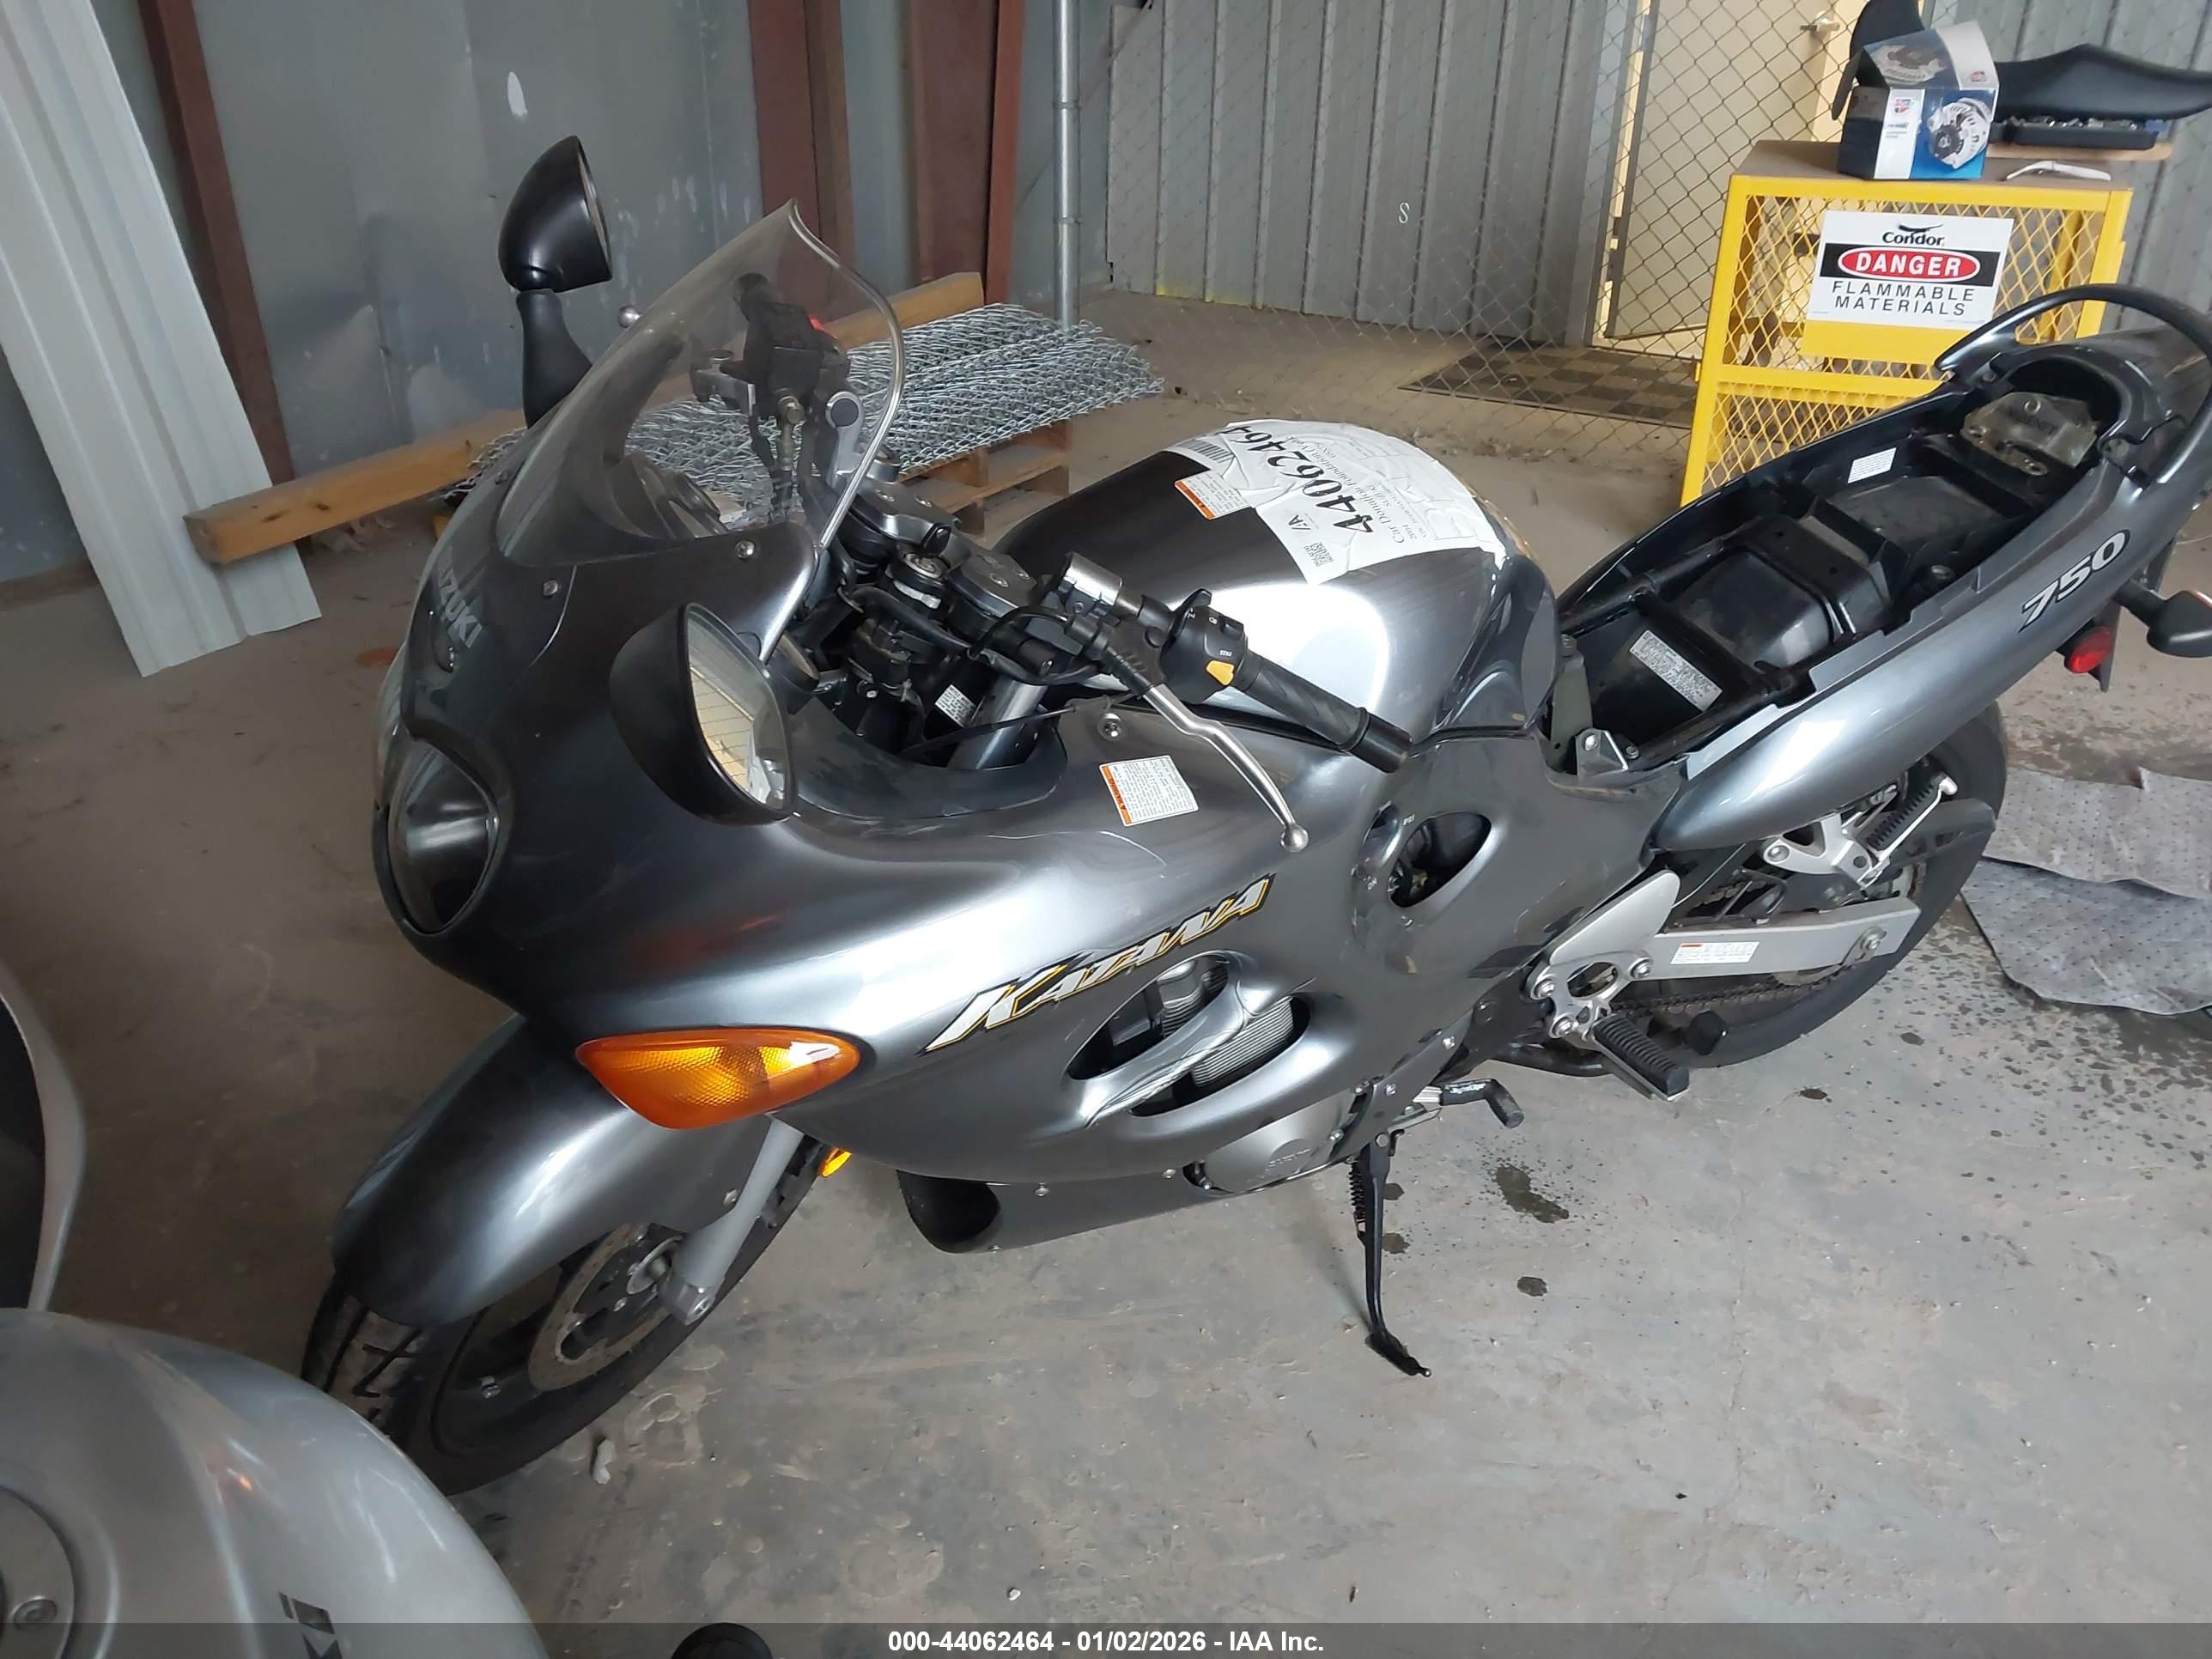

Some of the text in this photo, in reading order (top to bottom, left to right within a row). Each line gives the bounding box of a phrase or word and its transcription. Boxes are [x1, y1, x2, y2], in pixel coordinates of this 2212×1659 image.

[1882, 231, 1945, 246] Condor
[1856, 252, 1961, 276] DANGER
[1832, 281, 1975, 301] FLAMMABLE
[1835, 296, 1966, 316] MATERIALS
[1213, 426, 1374, 533] 44062464
[1312, 452, 1357, 487] Foundation
[1354, 487, 1391, 524] Donation
[1388, 526, 1405, 544] Car
[2019, 529, 2130, 633] 750
